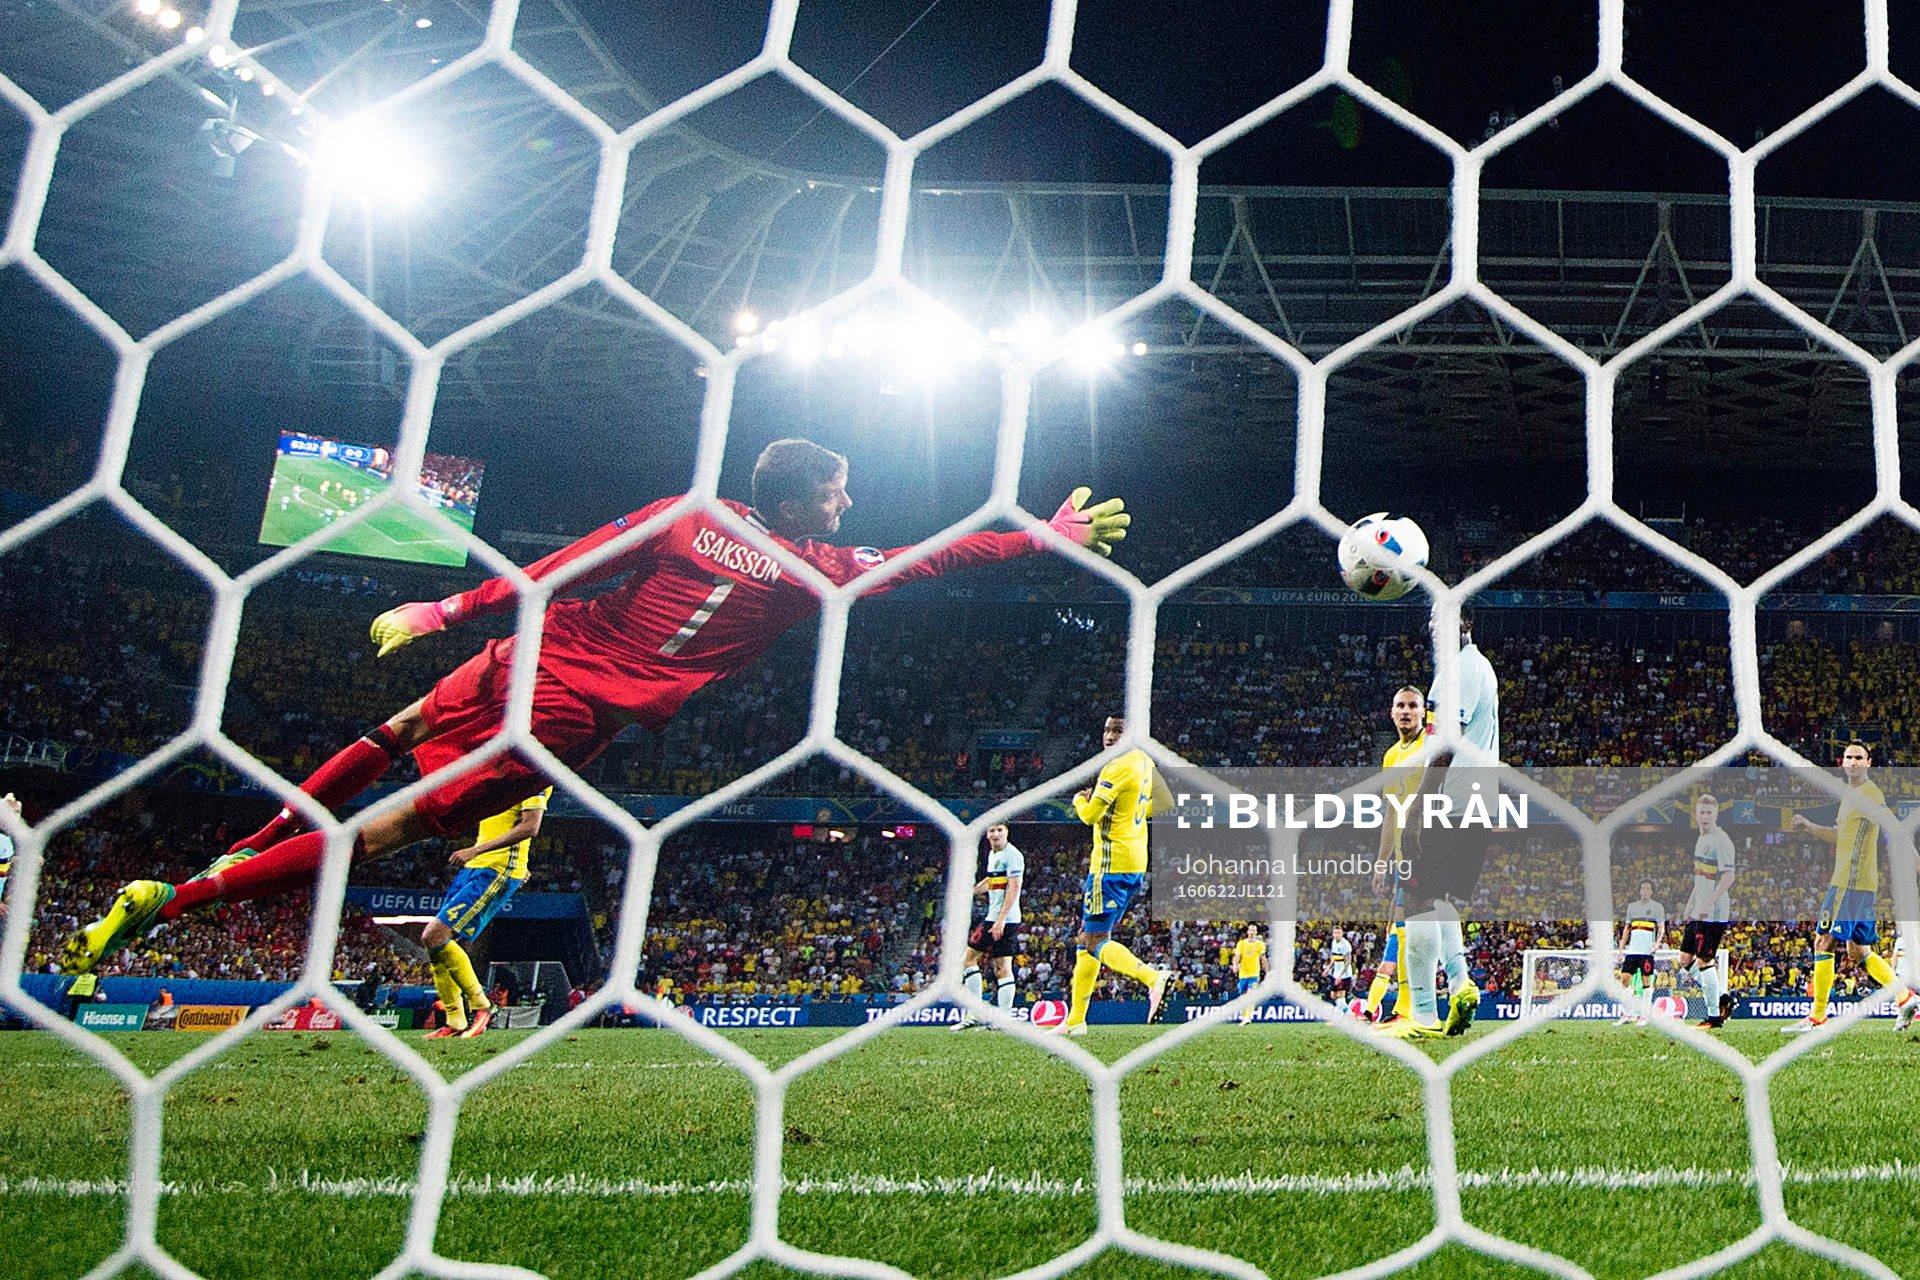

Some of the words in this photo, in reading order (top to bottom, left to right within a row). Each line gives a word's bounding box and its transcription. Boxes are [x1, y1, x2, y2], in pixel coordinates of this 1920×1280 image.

[692, 527, 782, 584] ISAKSSON
[1343, 592, 1371, 603] 20
[1660, 596, 1686, 606] NICE
[723, 803, 756, 816] NICE
[371, 894, 415, 910] UEFA
[866, 1008, 945, 1022] TUKISH
[1750, 1002, 1824, 1016] TURKIS
[83, 1011, 124, 1025] Hisense
[178, 1009, 233, 1028] Continental
[702, 1007, 801, 1026] RESPECT
